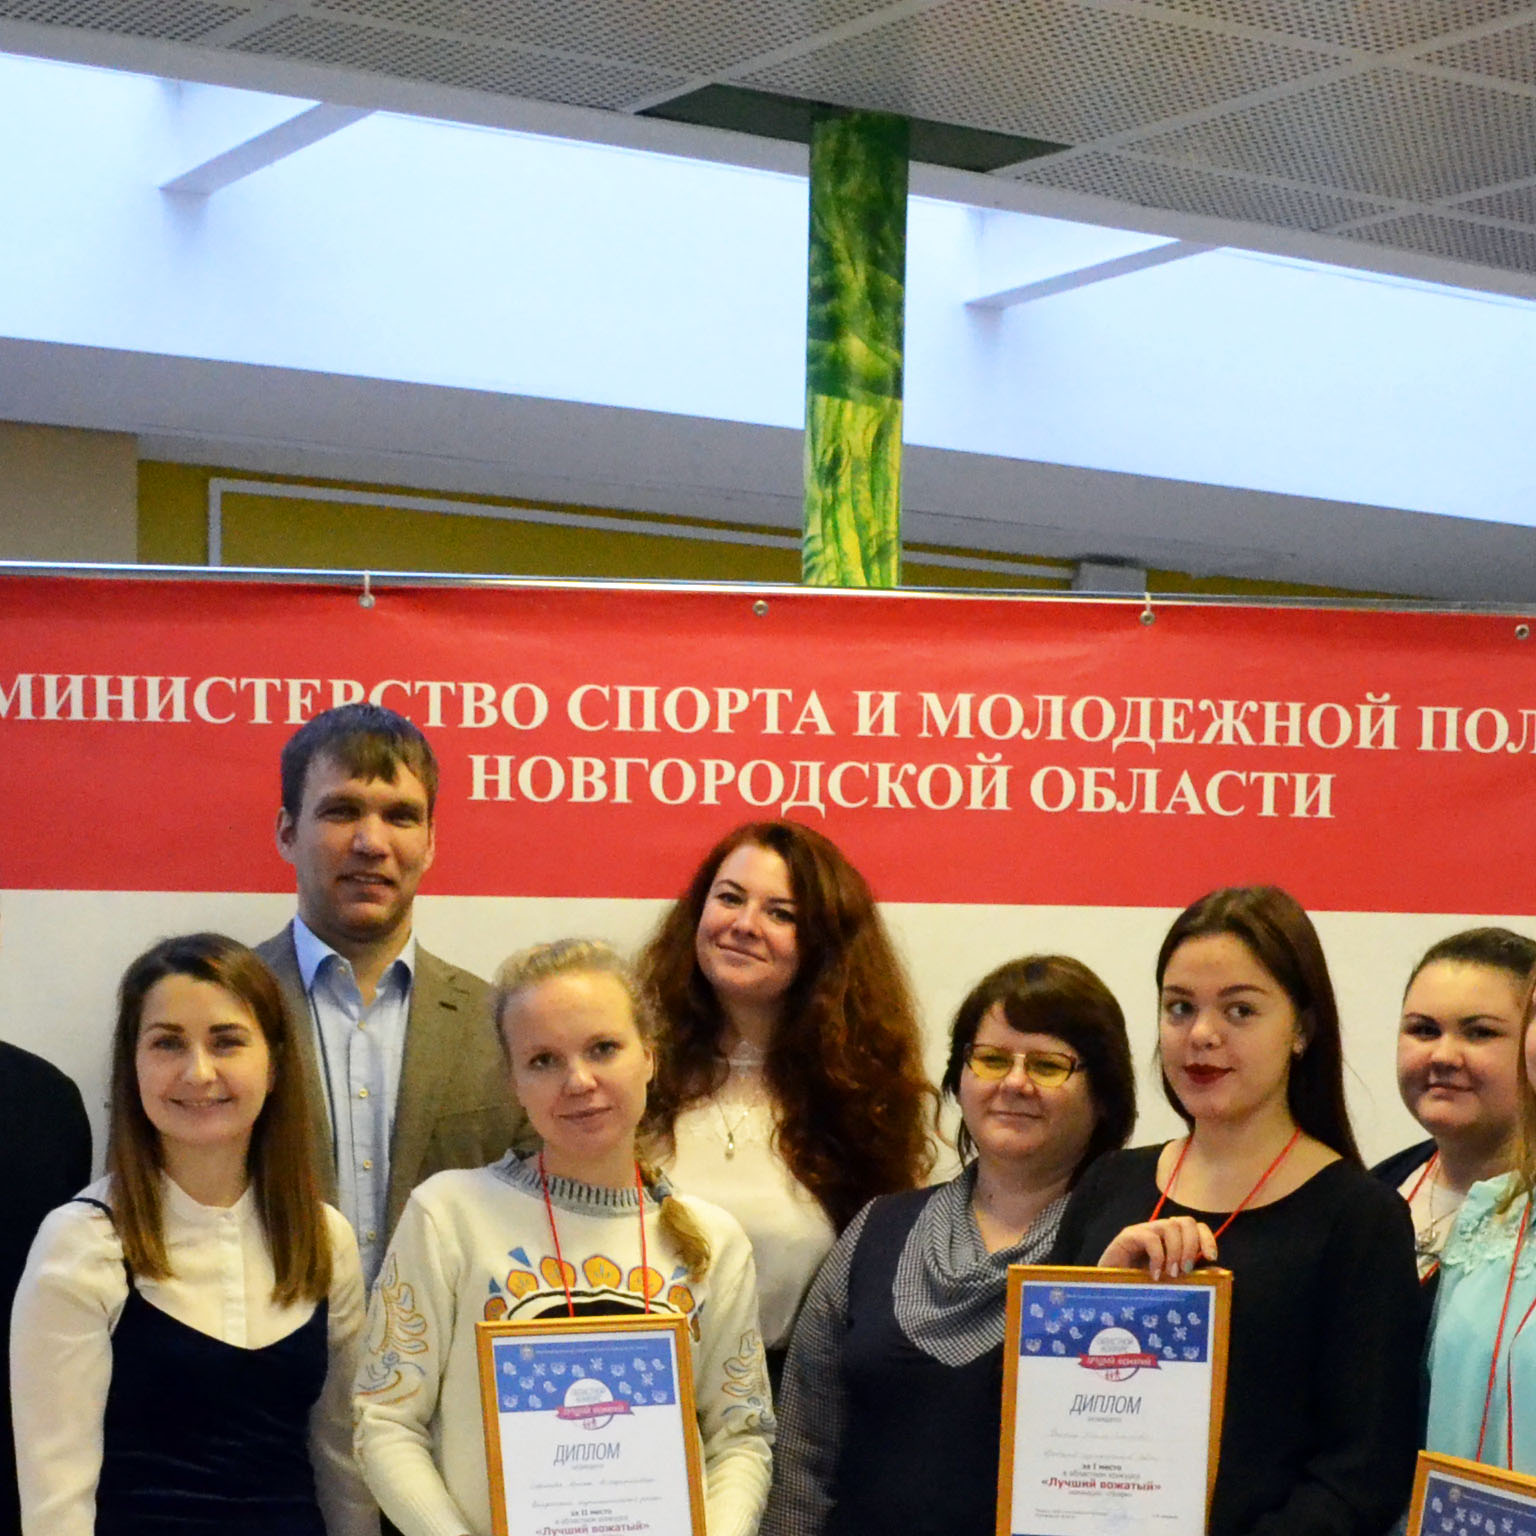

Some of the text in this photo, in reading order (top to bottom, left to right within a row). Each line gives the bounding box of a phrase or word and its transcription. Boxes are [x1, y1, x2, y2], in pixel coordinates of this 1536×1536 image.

[567, 684, 836, 736] СПОРТА
[853, 690, 901, 737] И
[917, 691, 1399, 754] МОЛОДЕЖНОЙ
[468, 751, 1336, 818] НОВГОРОДСКОЙ ОБЛАСТИ
[1069, 1393, 1143, 1416] ДИПЛОМ
[553, 1441, 621, 1466] ДИПЛОМ
[1041, 1477, 1162, 1492] «Лучший вожатый»
[591, 1521, 650, 1534] вожатый»
